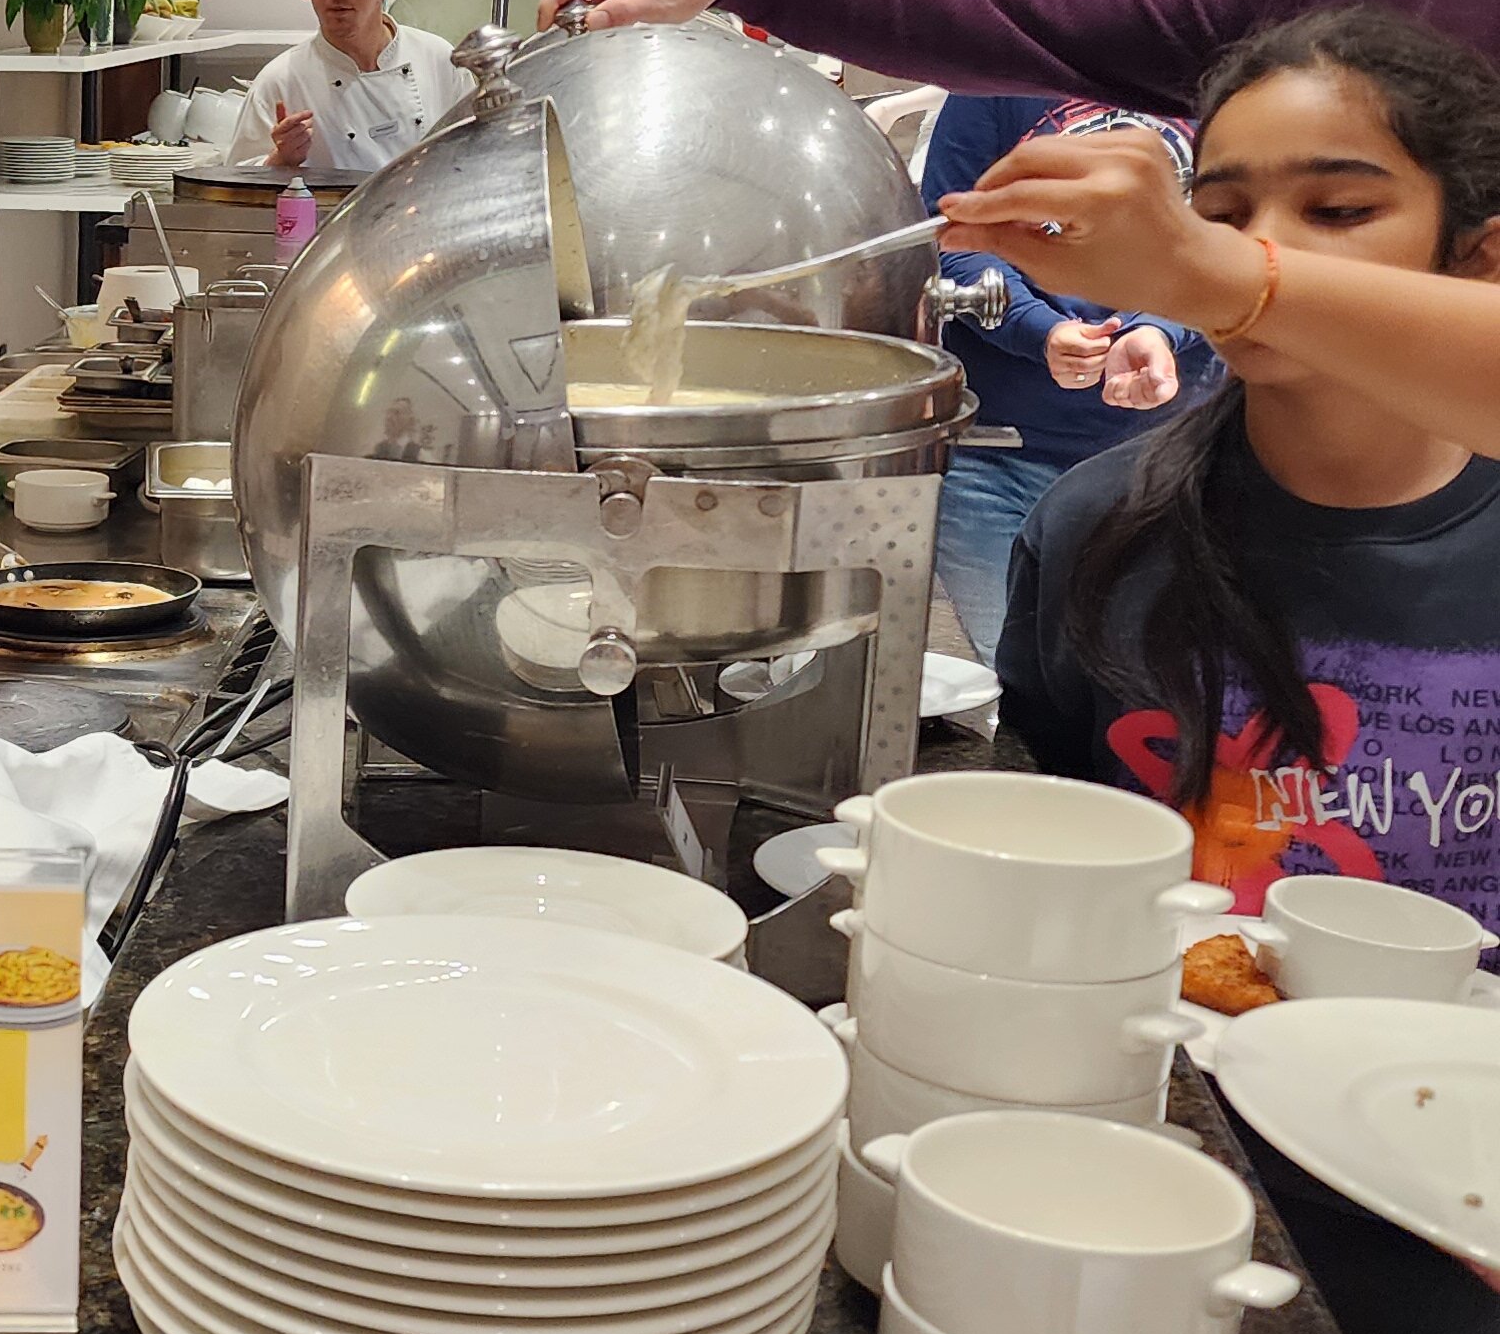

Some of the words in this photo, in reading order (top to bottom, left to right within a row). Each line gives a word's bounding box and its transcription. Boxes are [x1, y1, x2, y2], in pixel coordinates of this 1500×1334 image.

[1401, 713, 1455, 736] LOS
[1251, 757, 1394, 836] NEW
[1408, 766, 1500, 849] YO
[1434, 849, 1492, 870] NEW
